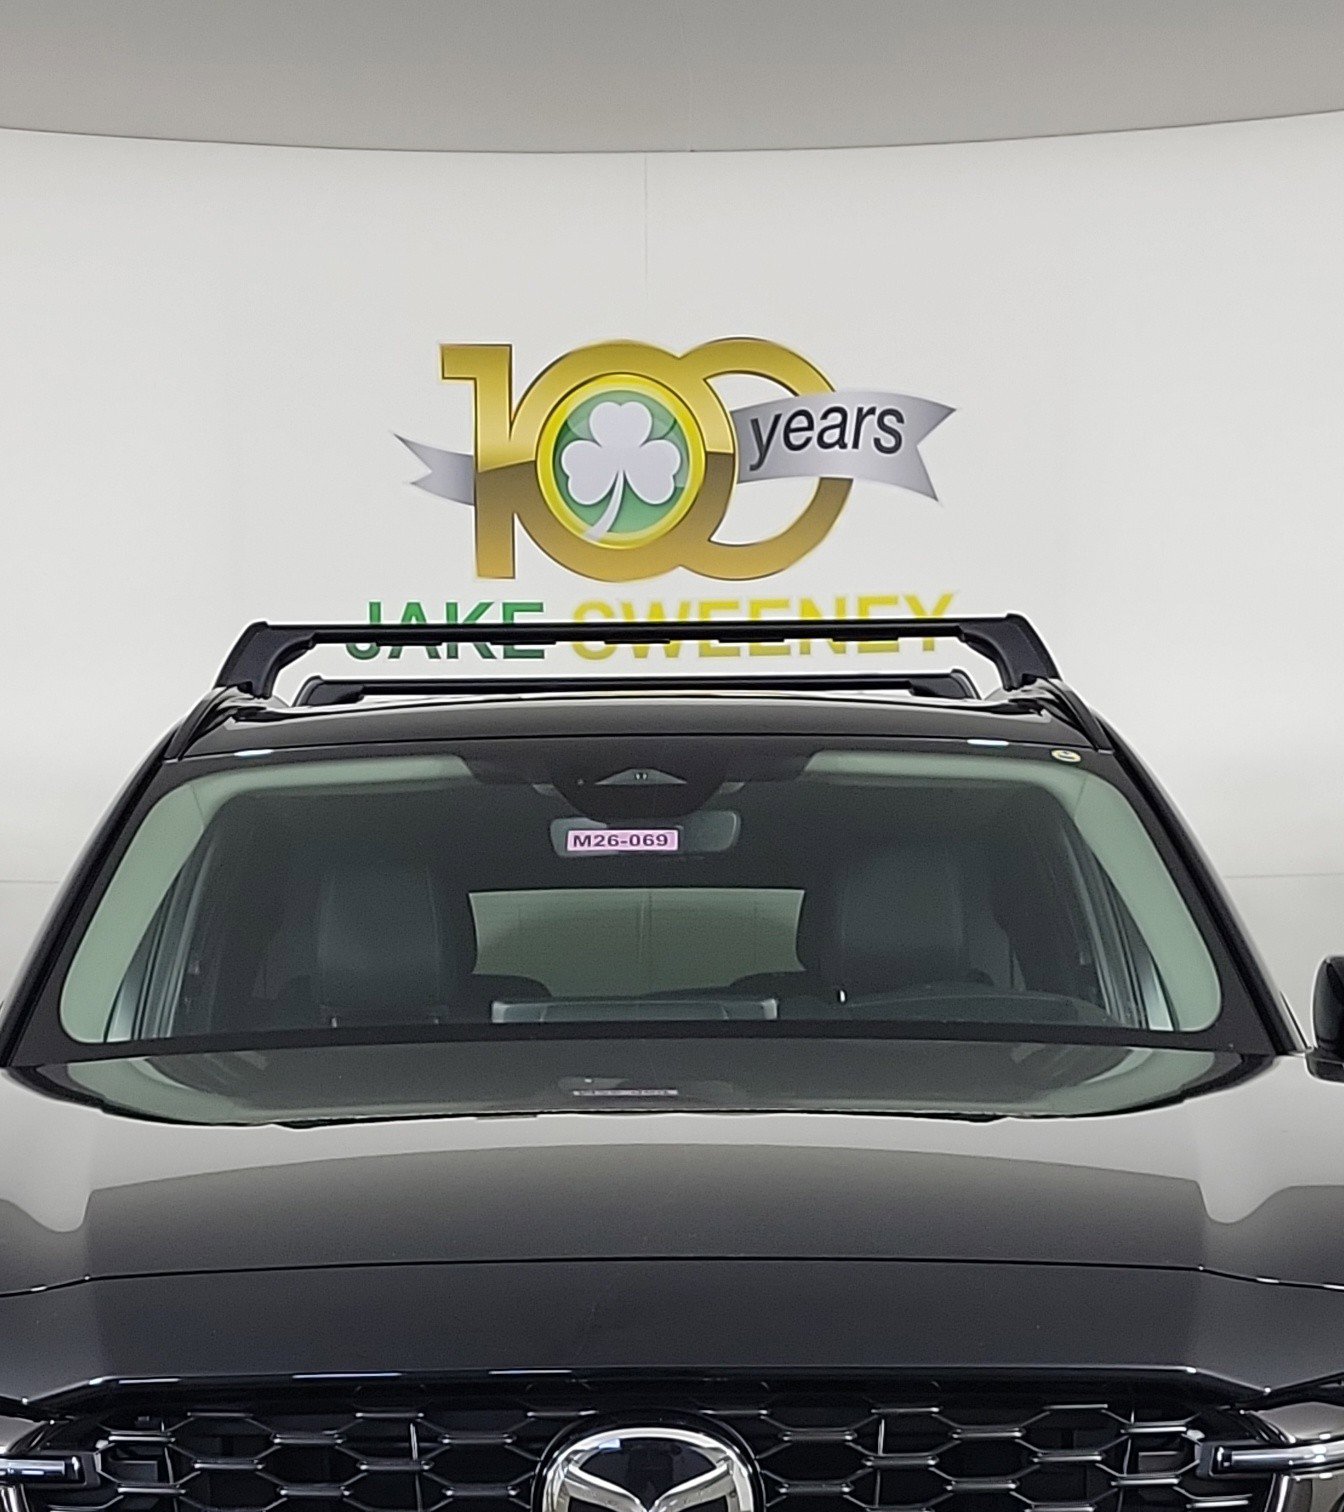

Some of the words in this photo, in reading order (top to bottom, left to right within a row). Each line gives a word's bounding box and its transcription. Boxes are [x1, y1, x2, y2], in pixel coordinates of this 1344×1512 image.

[440, 337, 853, 582] 100
[749, 404, 903, 471] years
[345, 601, 545, 660] JAKE
[571, 593, 953, 660] SWEENEY
[572, 833, 669, 848] M26-069
